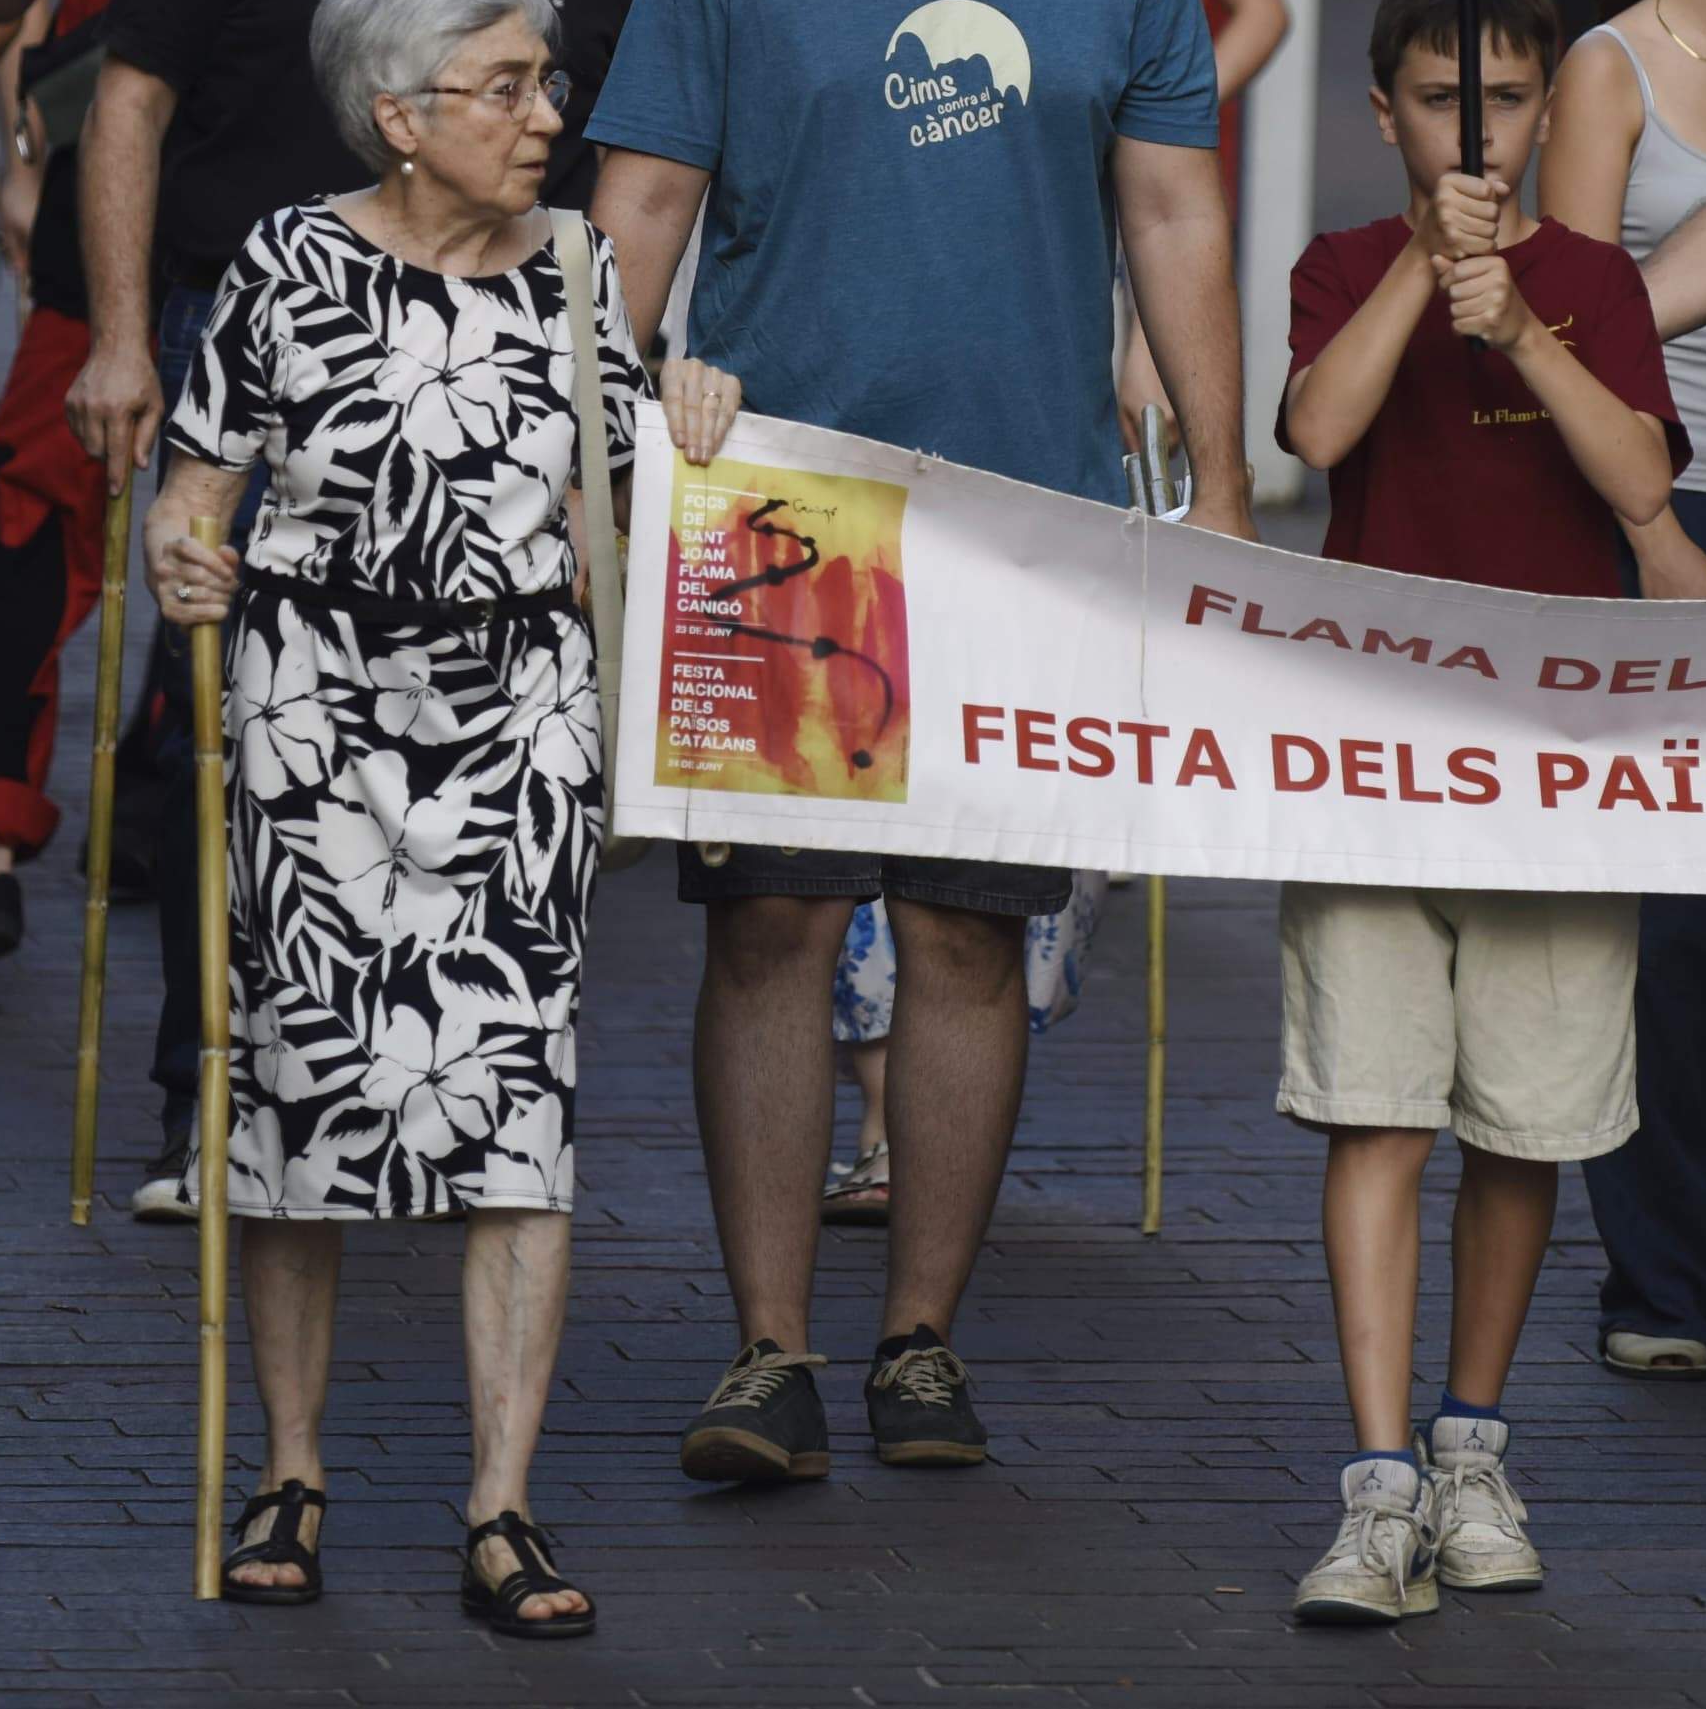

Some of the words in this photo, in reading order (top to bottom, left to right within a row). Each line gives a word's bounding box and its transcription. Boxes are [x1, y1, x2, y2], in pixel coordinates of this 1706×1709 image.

[885, 73, 958, 110] Cims
[938, 93, 978, 115] contra
[980, 86, 990, 102] el
[910, 103, 1004, 147] càncer
[1473, 411, 1490, 424] La
[1495, 409, 1537, 423] Flama
[684, 495, 727, 510] FOCS
[682, 512, 706, 525] DE
[681, 530, 725, 544] SANT
[680, 548, 725, 563] JOAN
[679, 564, 736, 581] FLAMA
[678, 581, 711, 596] DEL
[677, 598, 743, 616] CANIGÓ
[675, 625, 686, 635] 23
[689, 626, 702, 635] DE
[704, 627, 733, 637] JUNY
[1185, 584, 1499, 680] FLAMA
[673, 664, 725, 680] FESTA
[672, 681, 757, 700] NACIONAL
[671, 699, 713, 714] DELS
[670, 714, 730, 732] PAÏSOS
[669, 733, 757, 752] CATALANS
[961, 703, 1238, 791] FESTA
[1271, 733, 1502, 806] DELS
[680, 760, 694, 769] DE
[696, 760, 724, 772] JUNY
